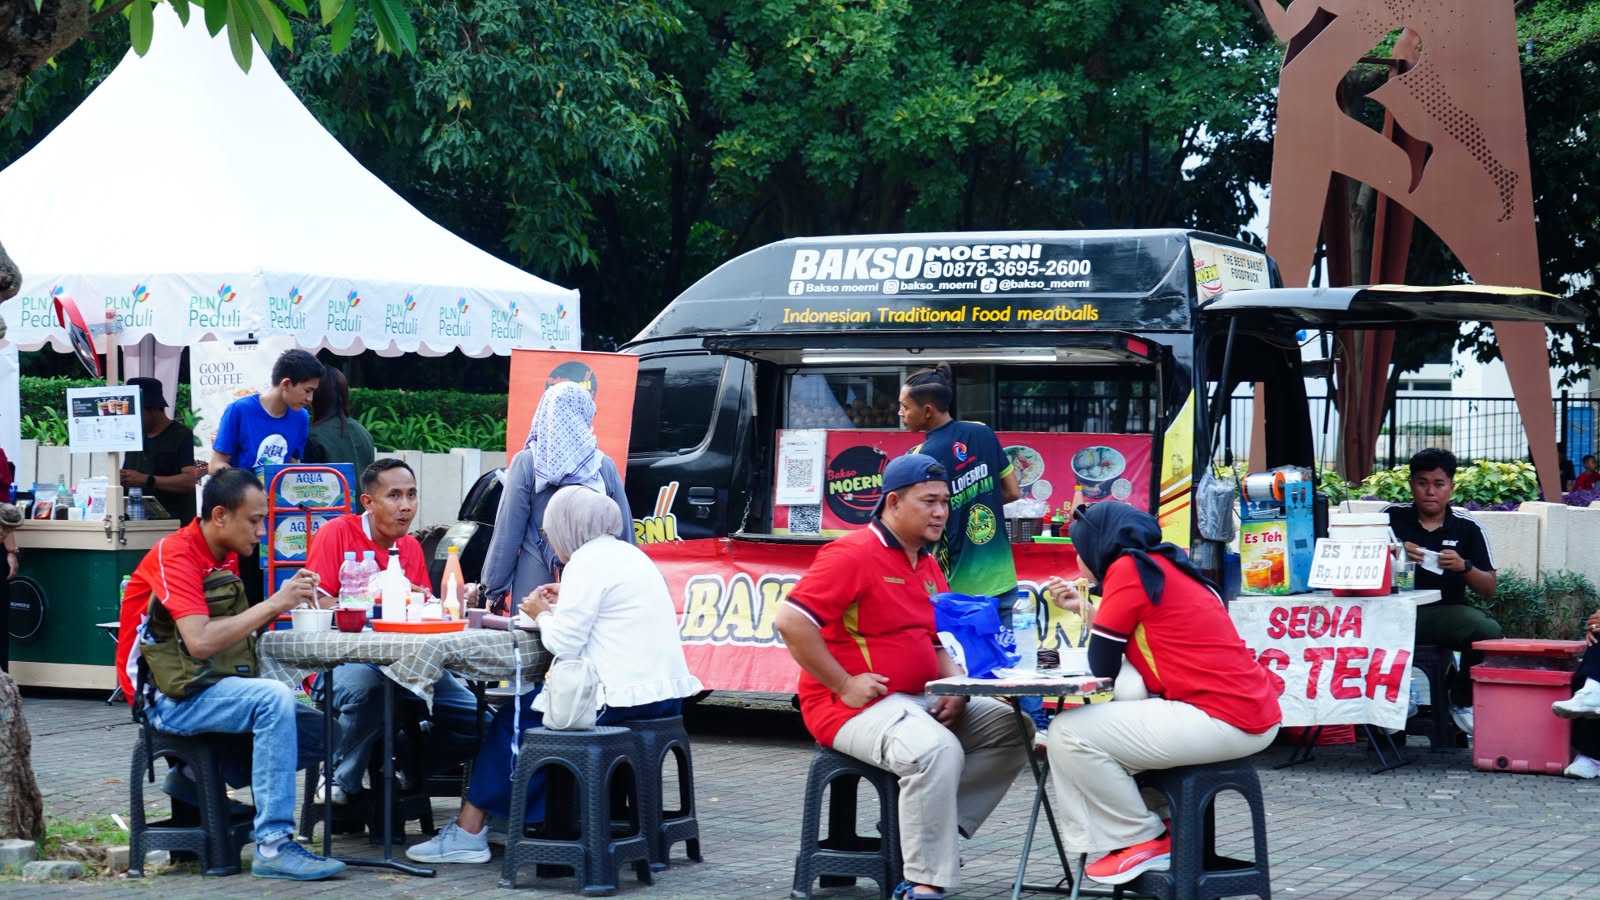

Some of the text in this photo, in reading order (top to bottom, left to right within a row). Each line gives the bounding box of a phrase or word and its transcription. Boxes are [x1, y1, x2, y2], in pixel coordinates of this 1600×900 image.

[925, 244, 1042, 261] MOERNI
[790, 246, 924, 280] BAKSO
[942, 260, 1091, 277] 0878-3695-2600
[1223, 254, 1233, 266] THE
[1234, 256, 1246, 269] BEST
[1231, 268, 1258, 282] FOODTRUCK
[806, 282, 878, 293] Bakso moerni
[900, 280, 977, 292] bakso_moerni
[998, 278, 1090, 291] @bakso_moerni
[22, 297, 47, 310] PLN
[105, 296, 130, 309] PLN
[189, 296, 215, 310] PLN
[269, 297, 288, 311] PLN
[328, 300, 345, 314] PLN
[116, 309, 153, 327] eduli
[386, 304, 403, 317] PLN
[440, 307, 457, 320] PLN
[492, 310, 509, 323] PLN
[783, 304, 1099, 323] Indonesian Traditional Food meatballs
[21, 310, 60, 328] Pedu
[189, 309, 241, 328] Peduli
[270, 310, 306, 331] Peduli
[327, 312, 362, 333] Peduli
[385, 316, 417, 335] Peduli
[541, 313, 556, 326] PLN
[439, 319, 471, 337] Peduli
[491, 322, 522, 340] Peduli
[541, 324, 570, 341] Peduli
[199, 362, 235, 375] GOOD
[199, 373, 243, 386] COFFEE
[296, 473, 323, 484] AQUA
[827, 469, 857, 480] Bakso
[829, 474, 883, 494] MOERN
[289, 521, 320, 533] AQA
[1244, 531, 1283, 544] Es Teh
[1321, 544, 1382, 559] ES TEH
[1316, 565, 1379, 582] Rp.10.000
[680, 574, 800, 645] BAK
[1267, 605, 1363, 640] SEDIA
[1247, 646, 1411, 703] S TEH
